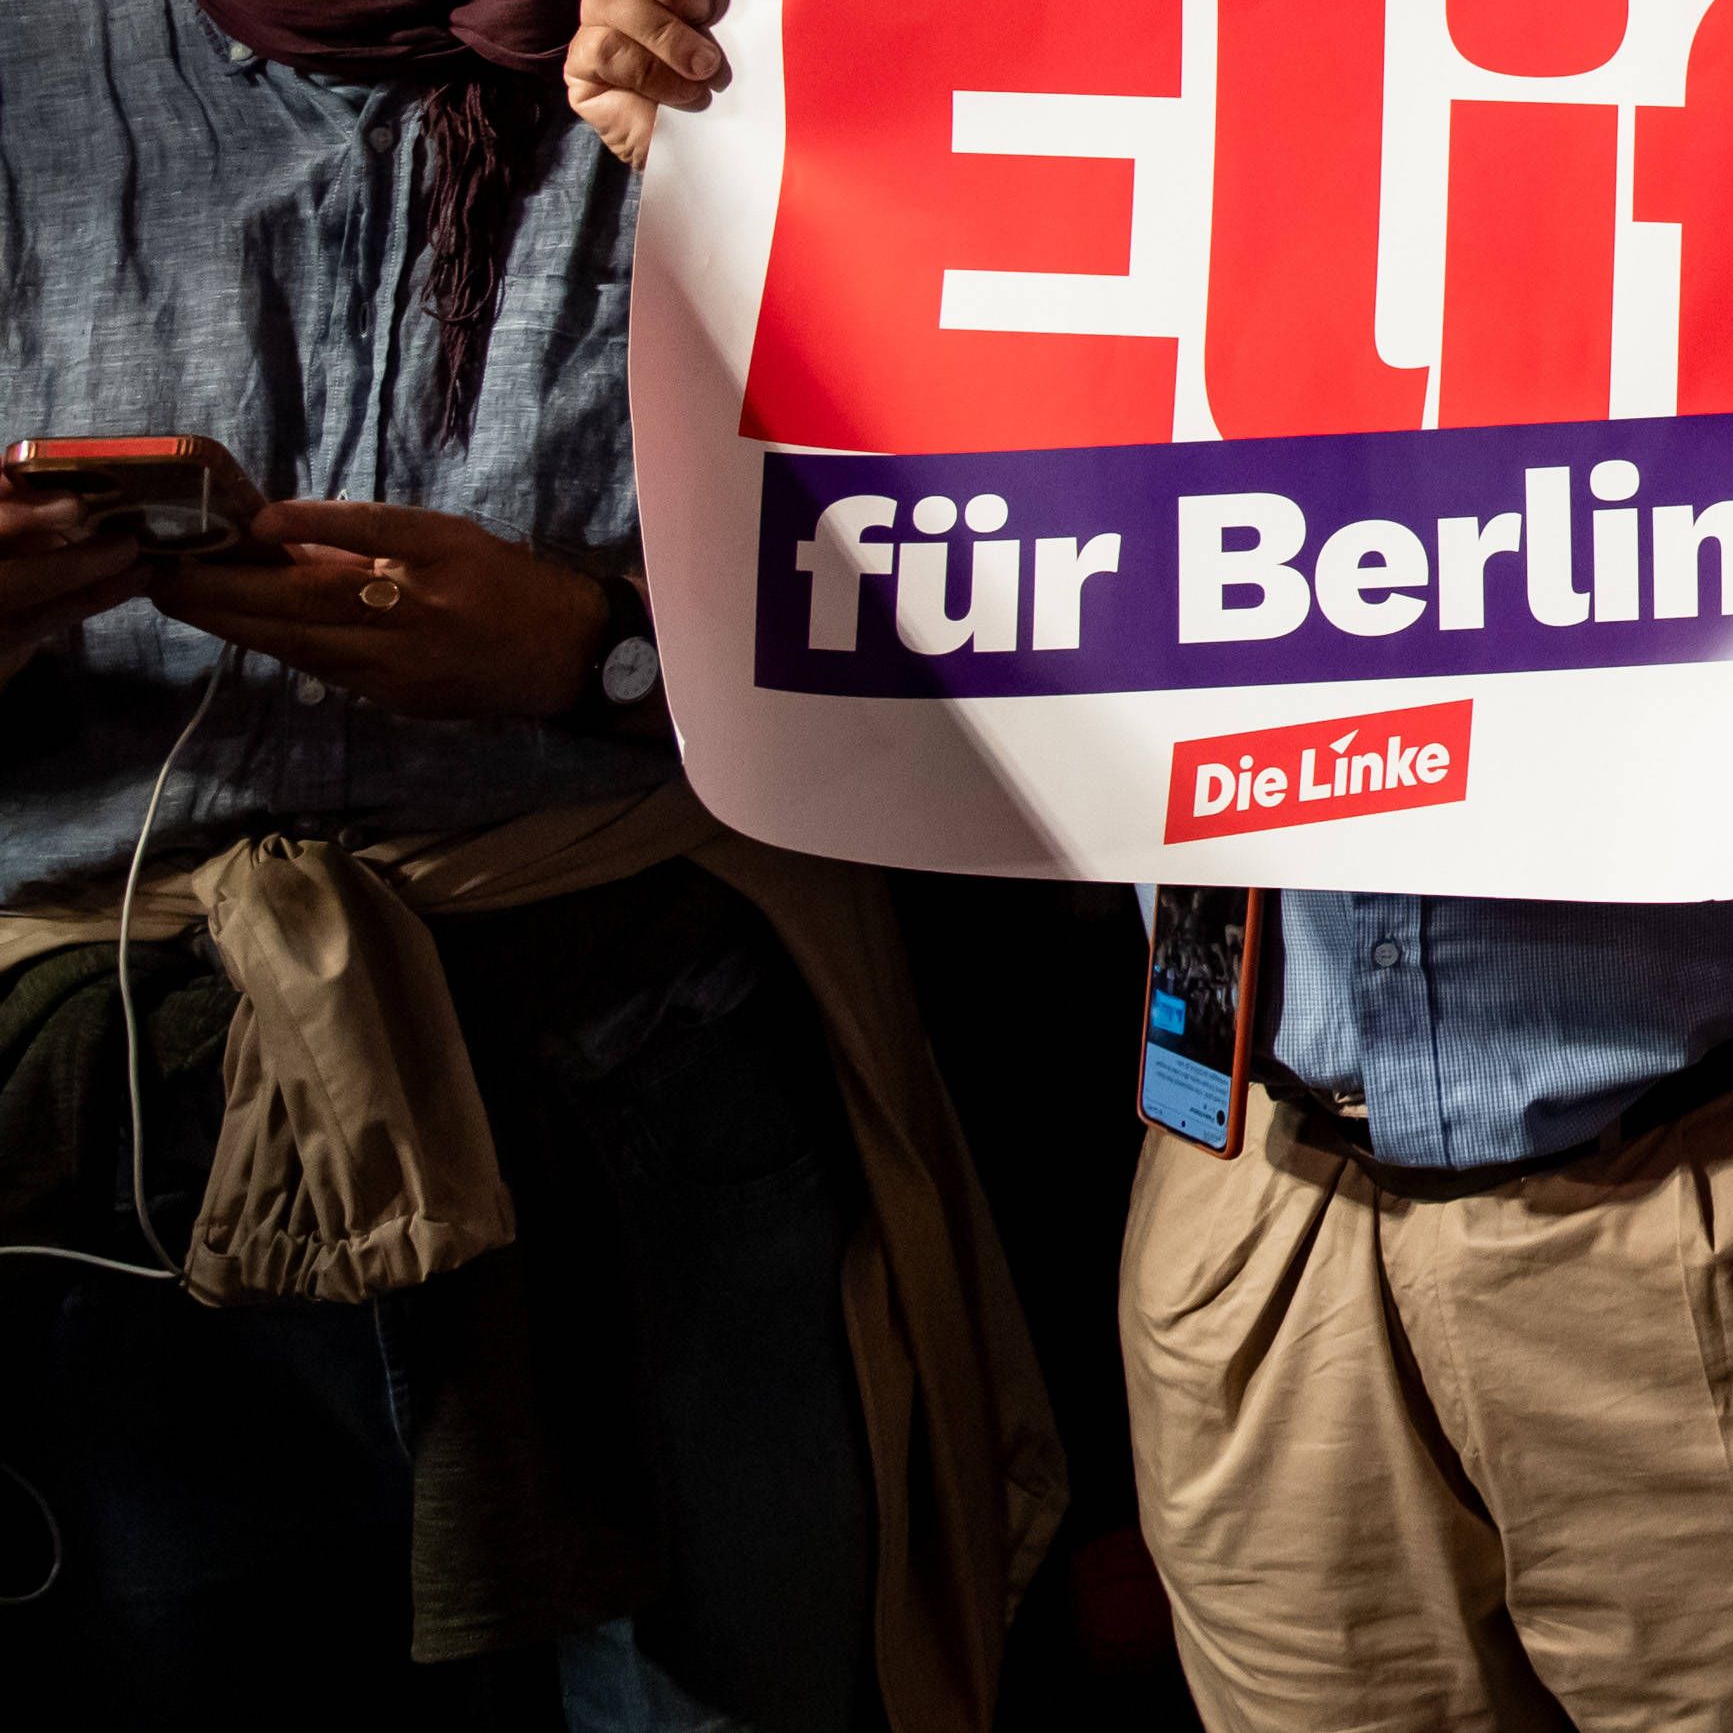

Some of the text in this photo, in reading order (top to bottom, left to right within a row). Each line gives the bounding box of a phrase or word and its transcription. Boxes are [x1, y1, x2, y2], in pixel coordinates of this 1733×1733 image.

[796, 494, 1122, 656] für
[1193, 729, 1451, 817] Die Linke
